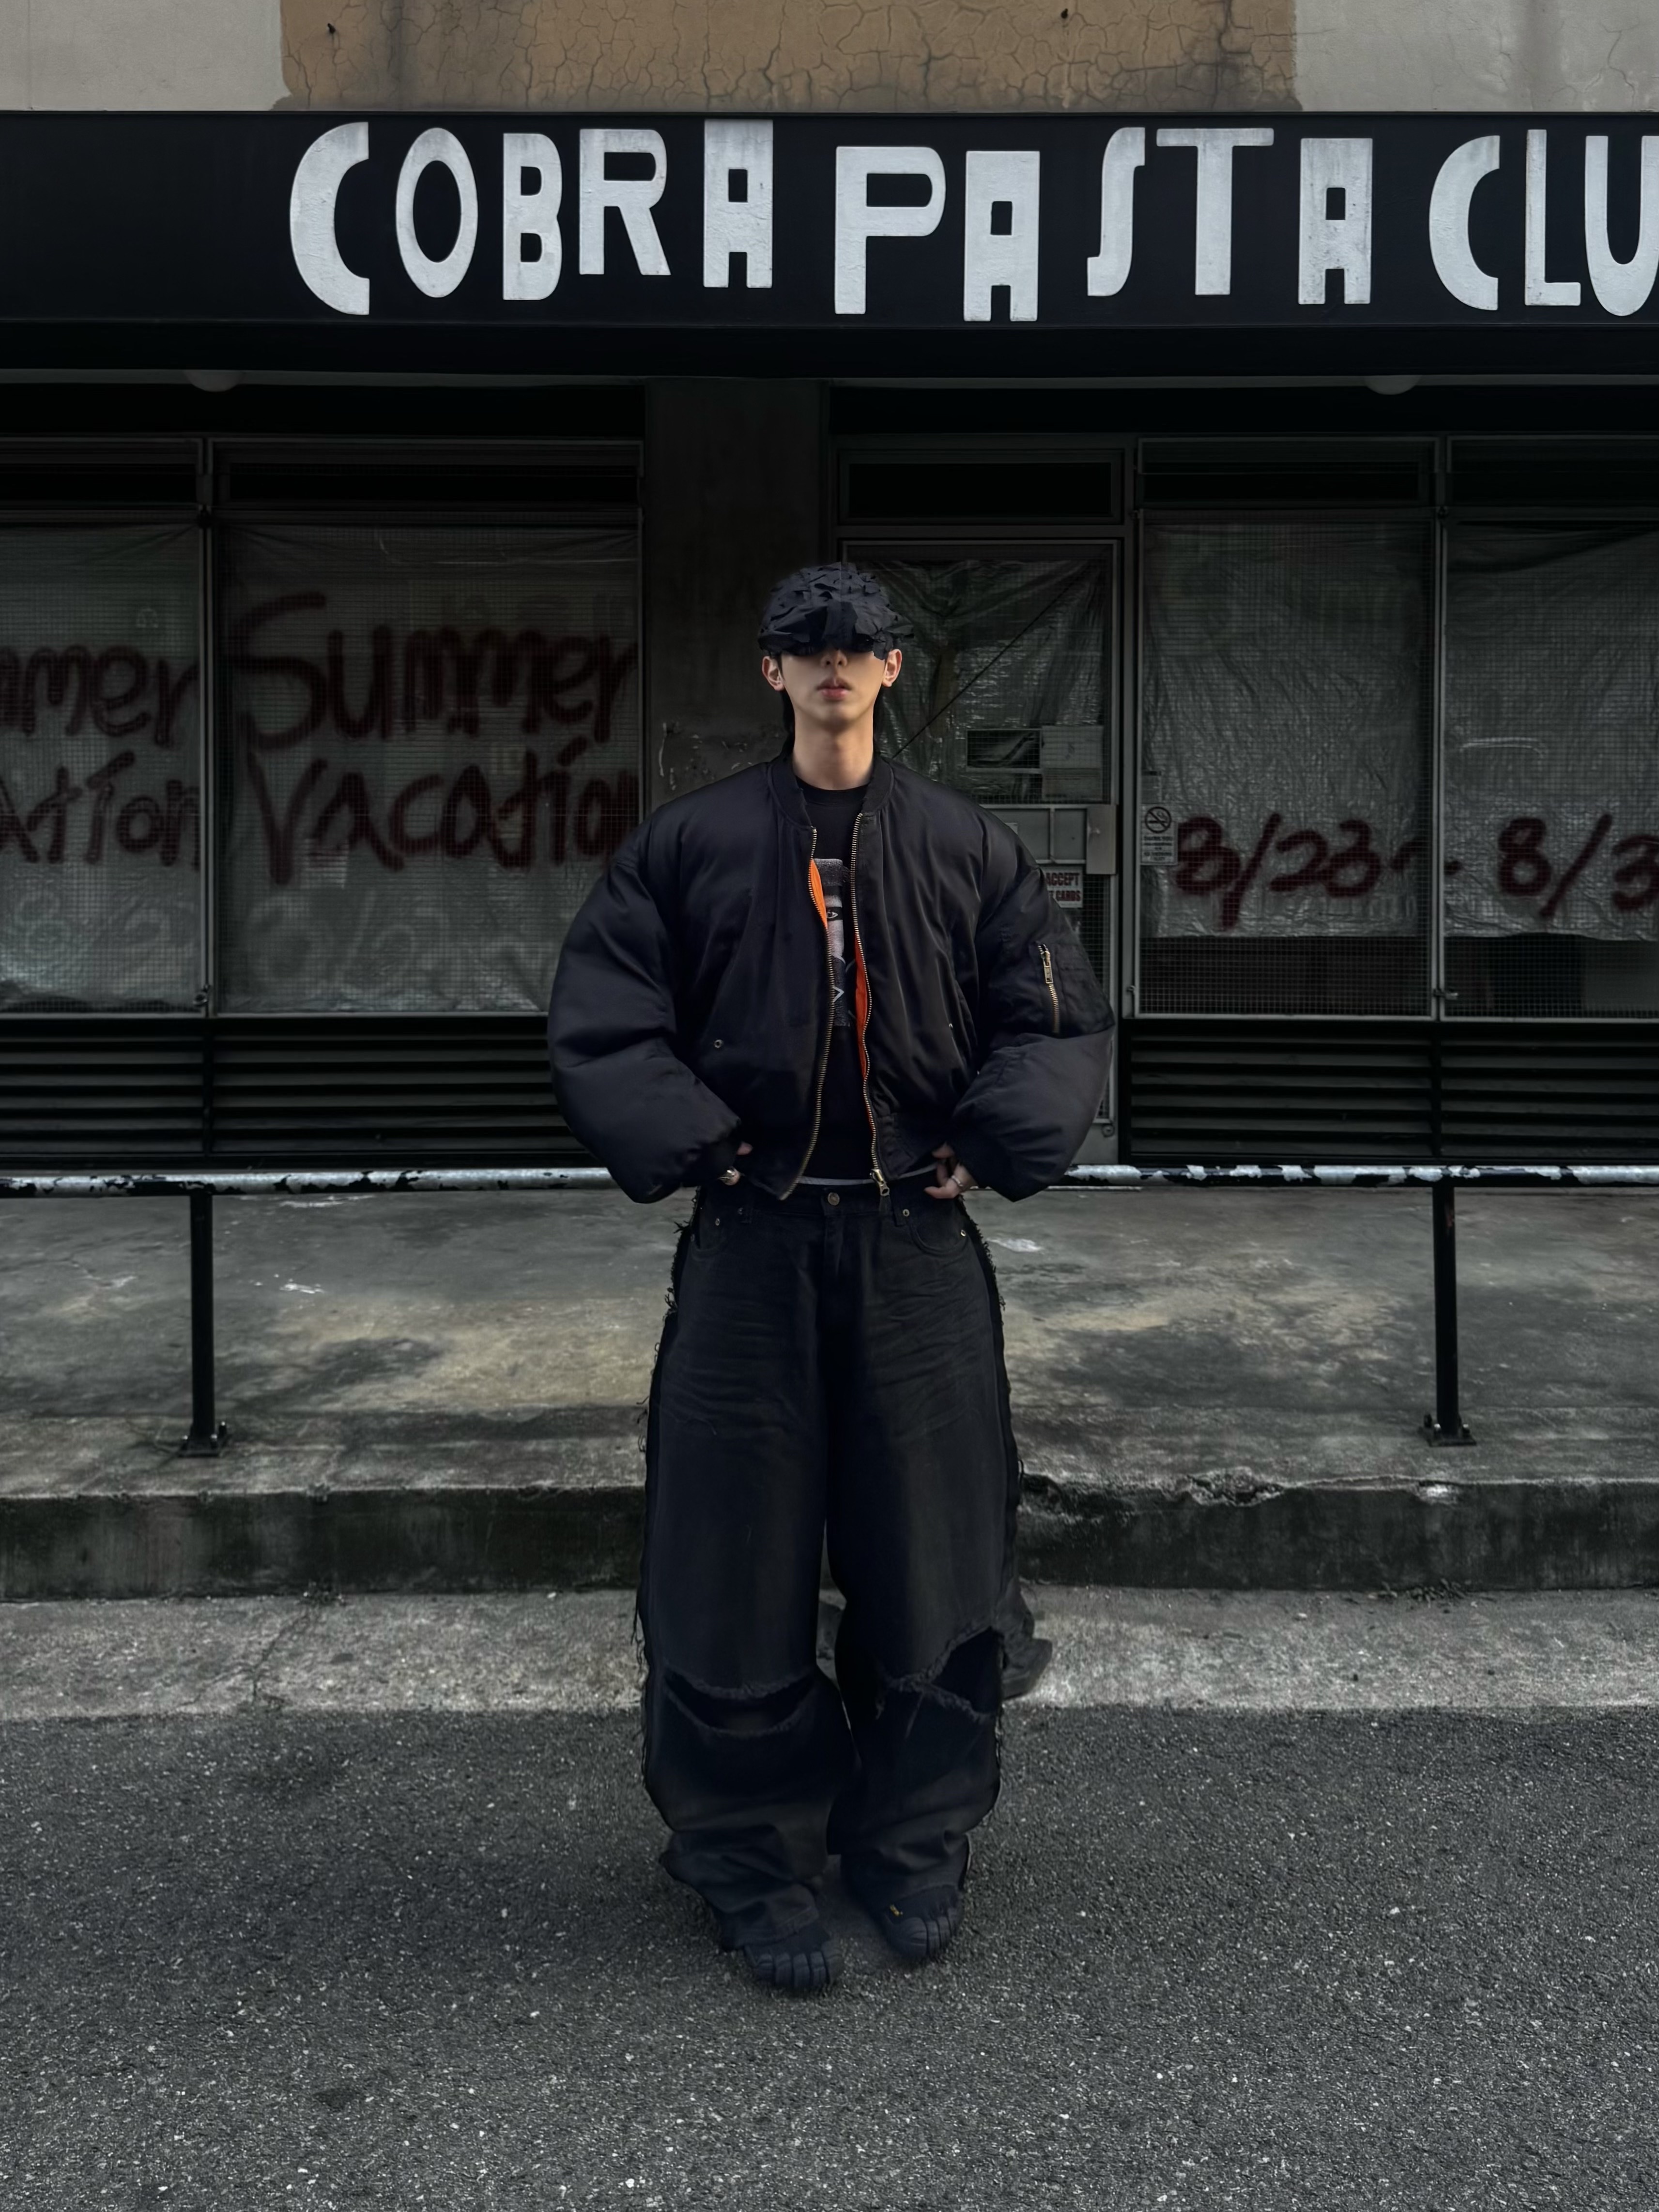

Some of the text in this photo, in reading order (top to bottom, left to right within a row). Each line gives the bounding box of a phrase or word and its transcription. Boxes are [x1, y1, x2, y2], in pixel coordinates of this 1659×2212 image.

[290, 119, 1659, 321] COBRA PASTA CLU
[229, 592, 638, 749] Summer
